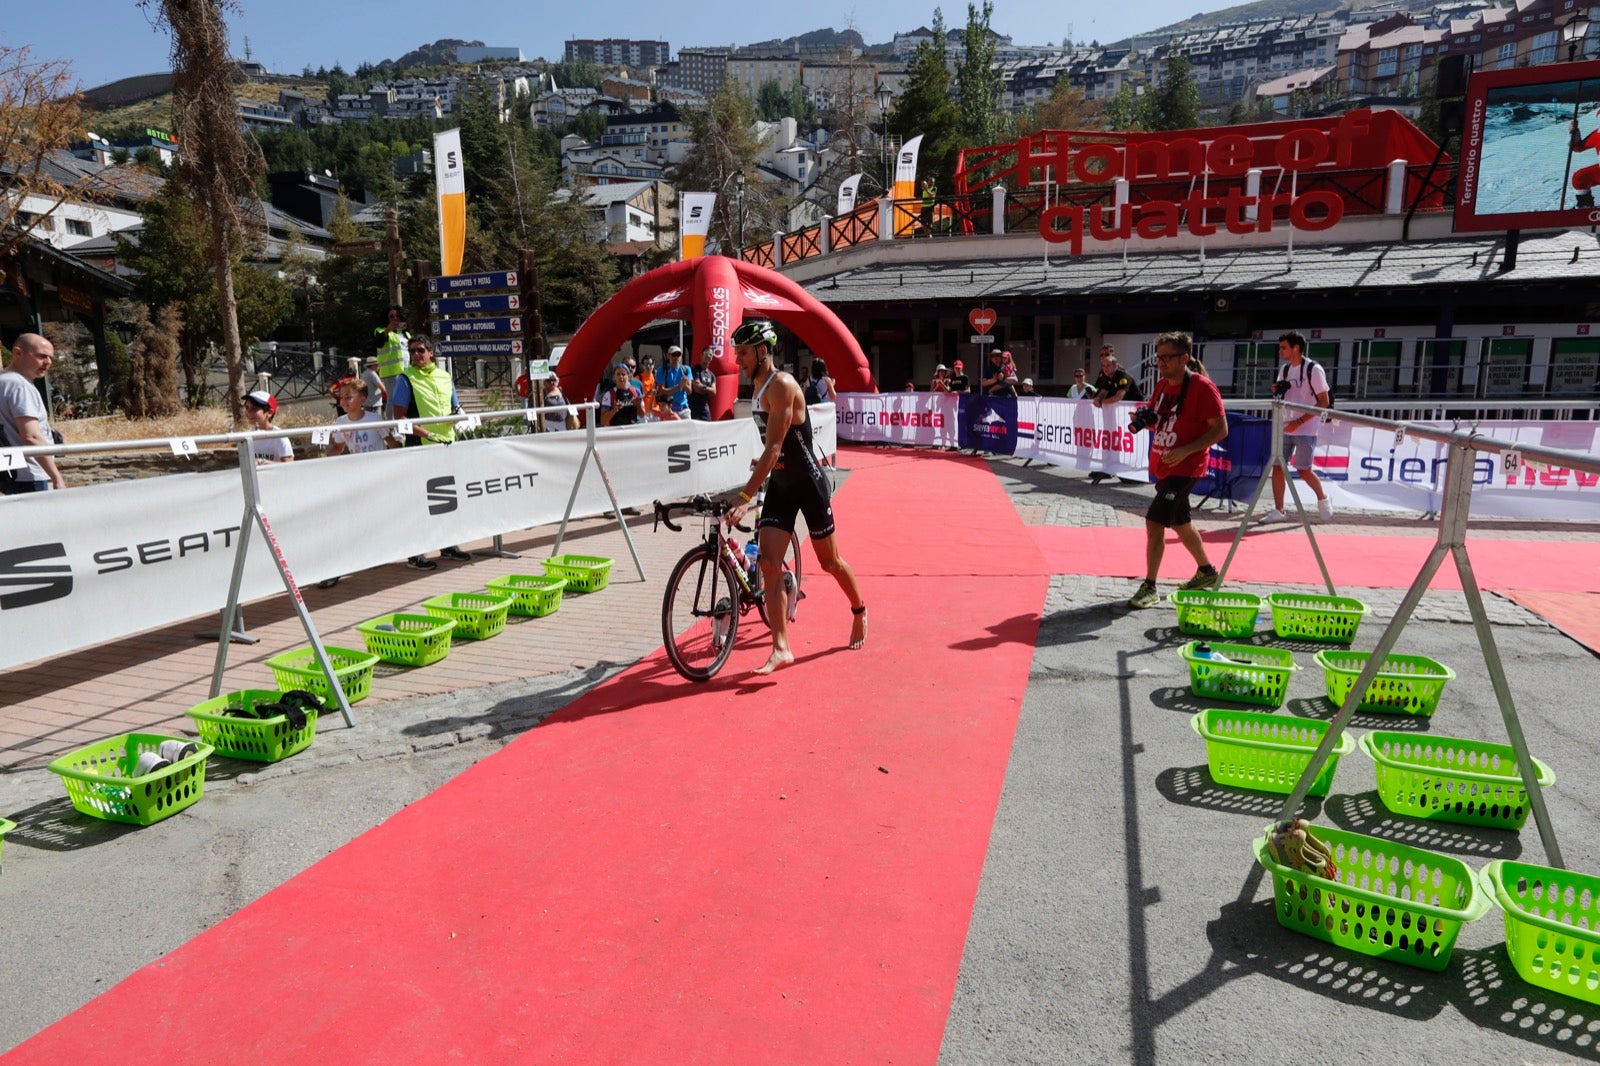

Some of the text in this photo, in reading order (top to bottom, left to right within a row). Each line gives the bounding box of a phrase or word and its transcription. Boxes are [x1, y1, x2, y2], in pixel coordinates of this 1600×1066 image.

[147, 128, 170, 141] HOTEL
[1017, 109, 1373, 187] Home of
[1461, 99, 1483, 206] Territorio quattro
[1038, 187, 1345, 255] quattro
[450, 279, 472, 287] REMONTES
[478, 277, 491, 285] PISTAS
[464, 301, 481, 309] CLINICA
[452, 322, 496, 331] PARKING AUTOBUSES
[453, 344, 478, 352] RECREATIVA
[879, 409, 945, 428] nevada
[319, 433, 324, 441] 5
[1037, 418, 1134, 453] sierra nevada
[182, 440, 190, 451] 6
[697, 443, 738, 462] SEAT
[4, 454, 12, 466] 7
[1360, 448, 1494, 484] siera
[1504, 454, 1518, 470] 64
[466, 472, 539, 498] SEAT
[93, 525, 240, 575] SEAT
[280, 559, 288, 568] DE
[285, 569, 303, 605] GRANADA
